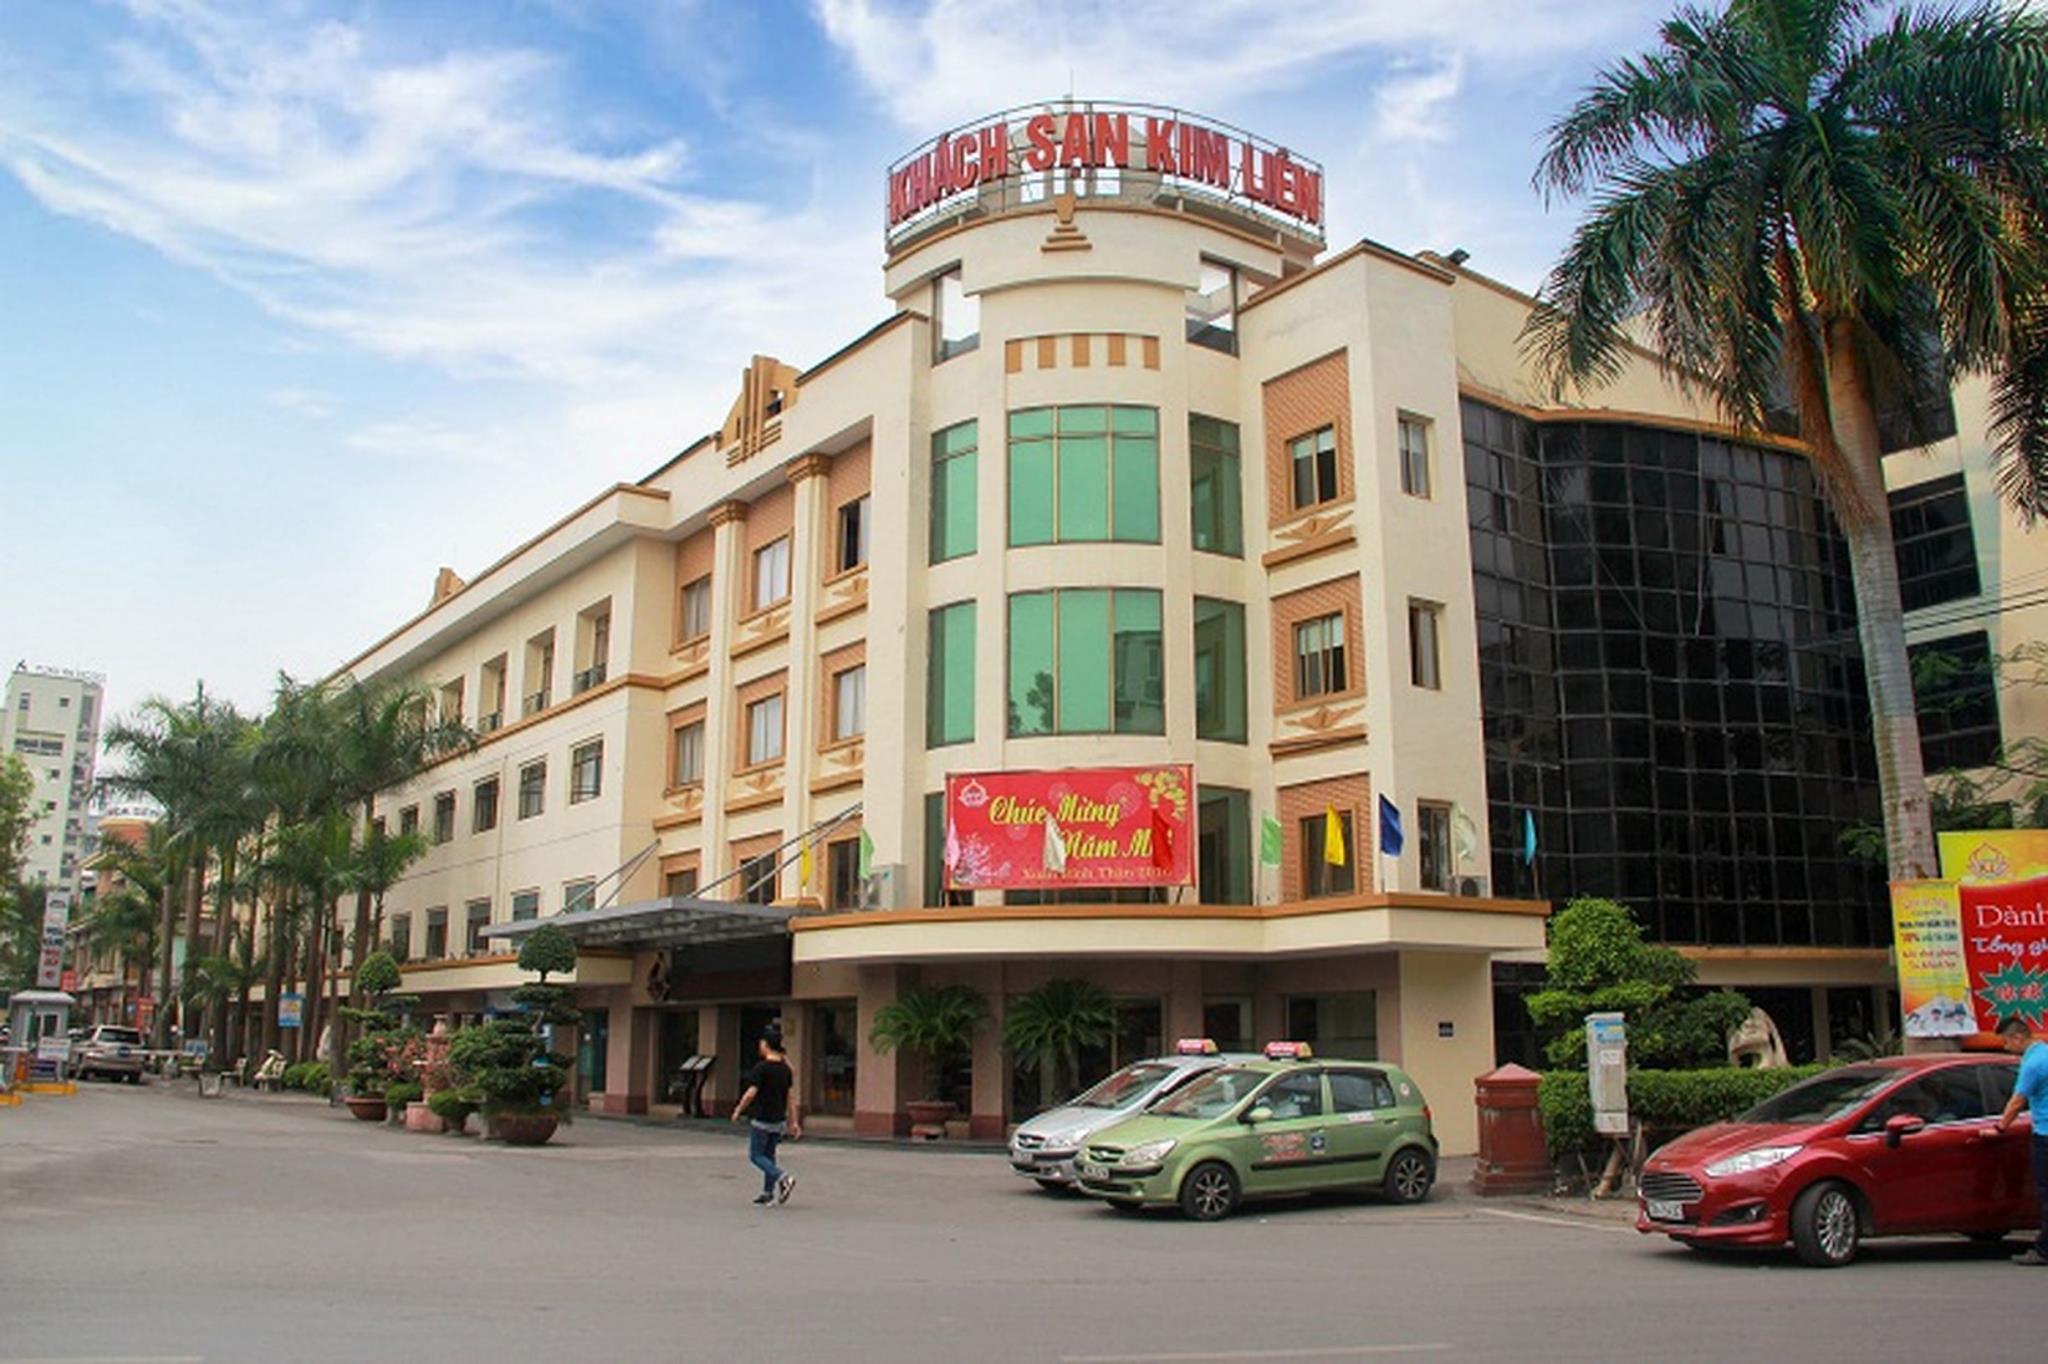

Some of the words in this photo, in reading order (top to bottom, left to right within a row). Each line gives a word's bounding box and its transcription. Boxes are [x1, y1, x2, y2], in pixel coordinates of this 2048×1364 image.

[888, 121, 1008, 225] KHÁCH
[1025, 112, 1131, 178] SẠN
[1146, 116, 1230, 191] KIM
[1241, 142, 1322, 225] LIÊN
[988, 795, 1048, 826] Chúc
